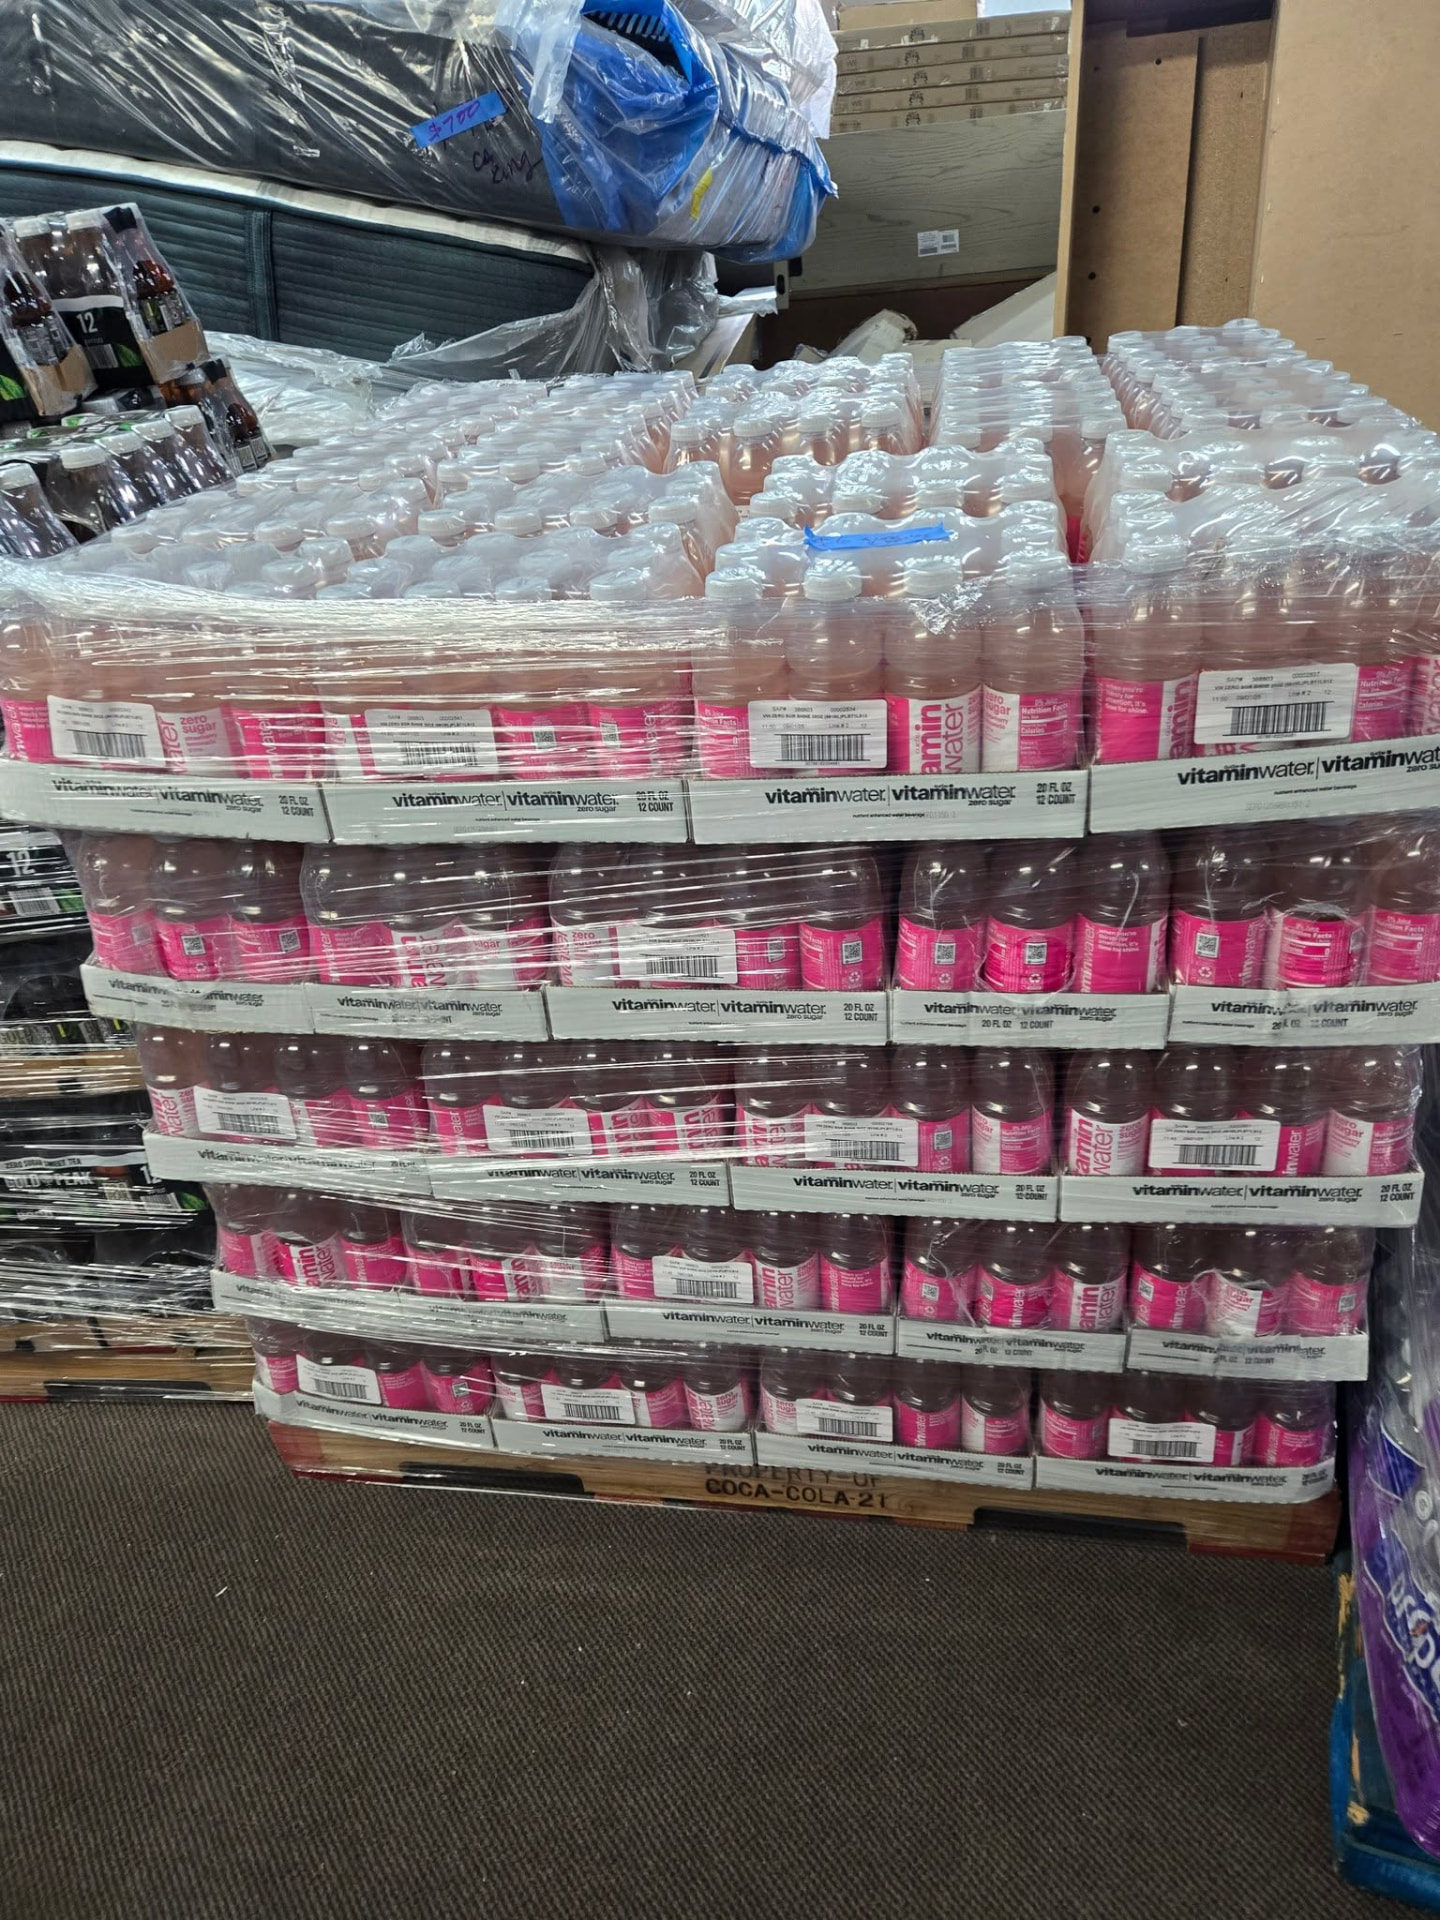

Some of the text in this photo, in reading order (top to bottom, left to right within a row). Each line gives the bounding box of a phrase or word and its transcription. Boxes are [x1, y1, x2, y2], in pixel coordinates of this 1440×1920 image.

[428, 100, 480, 142] $700
[77, 312, 98, 335] 12
[179, 715, 207, 724] zero
[182, 722, 217, 735] sugar
[1178, 758, 1314, 785] vitaminwater
[160, 790, 264, 807] vitaminwater
[392, 793, 619, 808] vitaminwater vitaminwater
[765, 786, 1016, 805] vitaminwater vitaminwater
[638, 802, 673, 812] 12 COUNT
[6, 850, 36, 878] 12
[720, 1001, 827, 1016] vitaminwater
[843, 1003, 875, 1012] 20 FL OZ
[924, 1003, 1016, 1016] vitaminwater
[845, 1013, 878, 1021] 12 COUNT
[581, 1168, 675, 1181] vitaminwater
[793, 1176, 999, 1195] vitaminwater vitaminwater
[1132, 1183, 1363, 1199] vitaminwater vitaminwater
[662, 1312, 844, 1331] vitaminwater vitaminwater
[808, 1443, 893, 1460] vitaminwater
[706, 1478, 850, 1507] COCA-COLA
